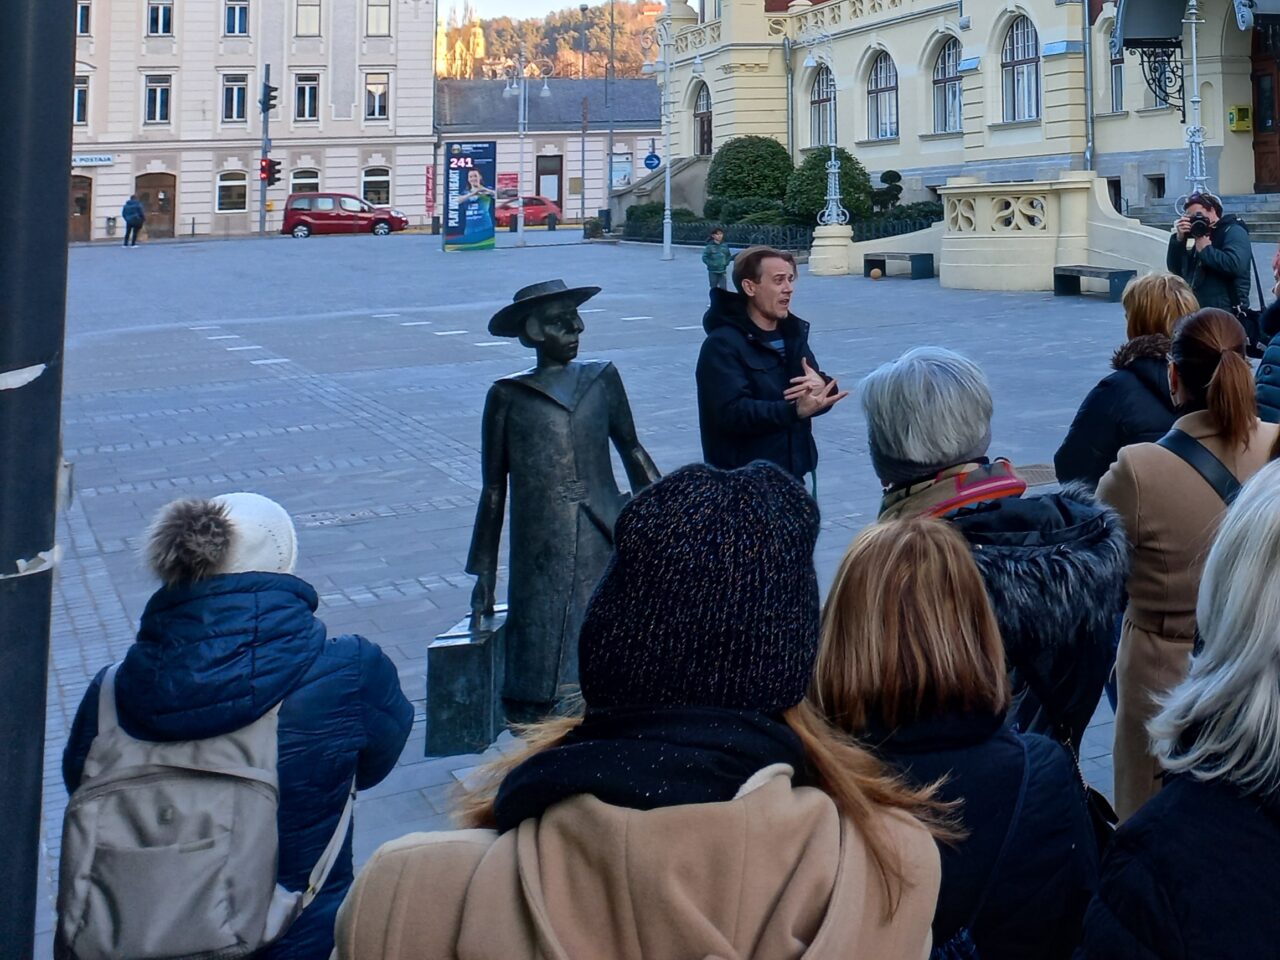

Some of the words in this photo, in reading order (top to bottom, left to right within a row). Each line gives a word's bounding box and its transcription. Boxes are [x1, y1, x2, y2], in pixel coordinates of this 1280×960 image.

[449, 157, 474, 168] 241
[448, 169, 460, 190] HEART
[448, 190, 460, 209] WITH
[448, 209, 460, 227] PLAY
